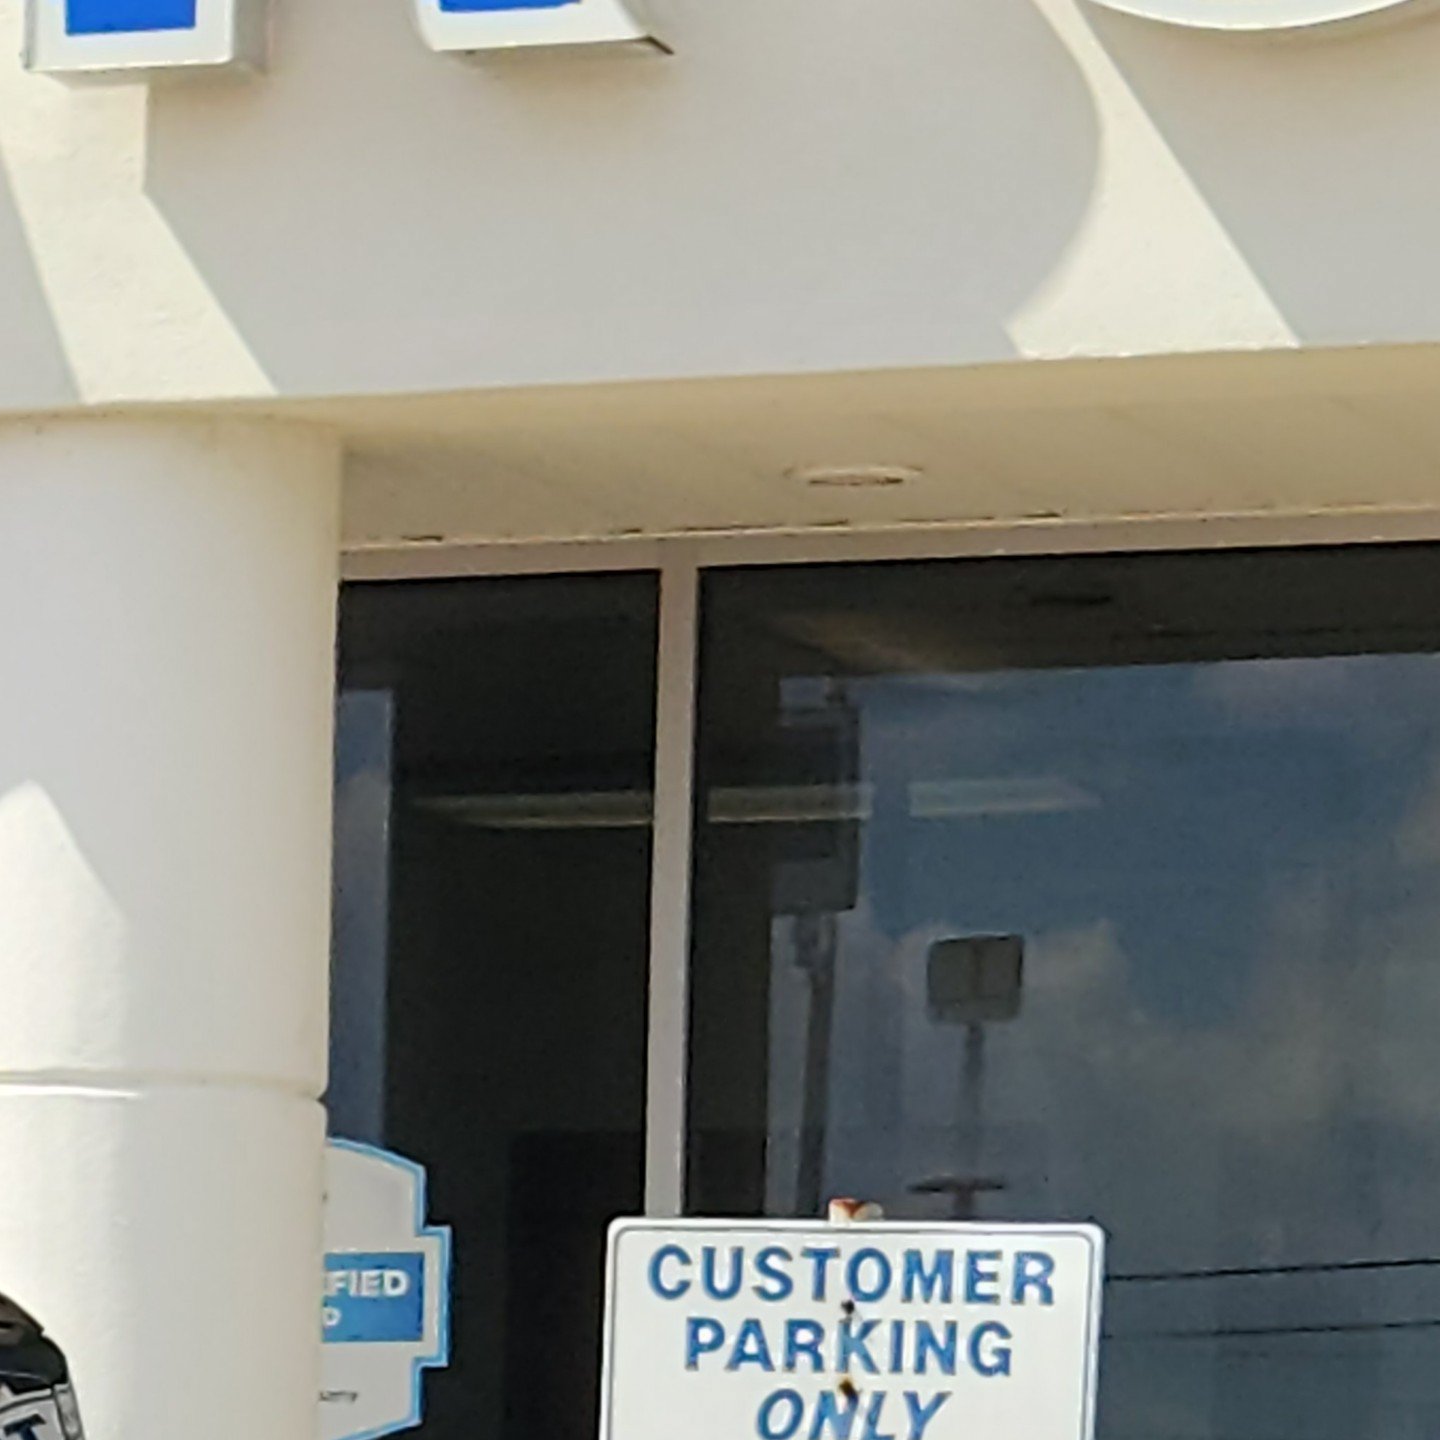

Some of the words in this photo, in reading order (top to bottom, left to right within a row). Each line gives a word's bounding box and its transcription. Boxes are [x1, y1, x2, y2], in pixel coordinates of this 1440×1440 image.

[325, 1269, 410, 1297] FIED
[647, 1244, 1056, 1305] CUSTOMER
[684, 1316, 1013, 1377] PARKING
